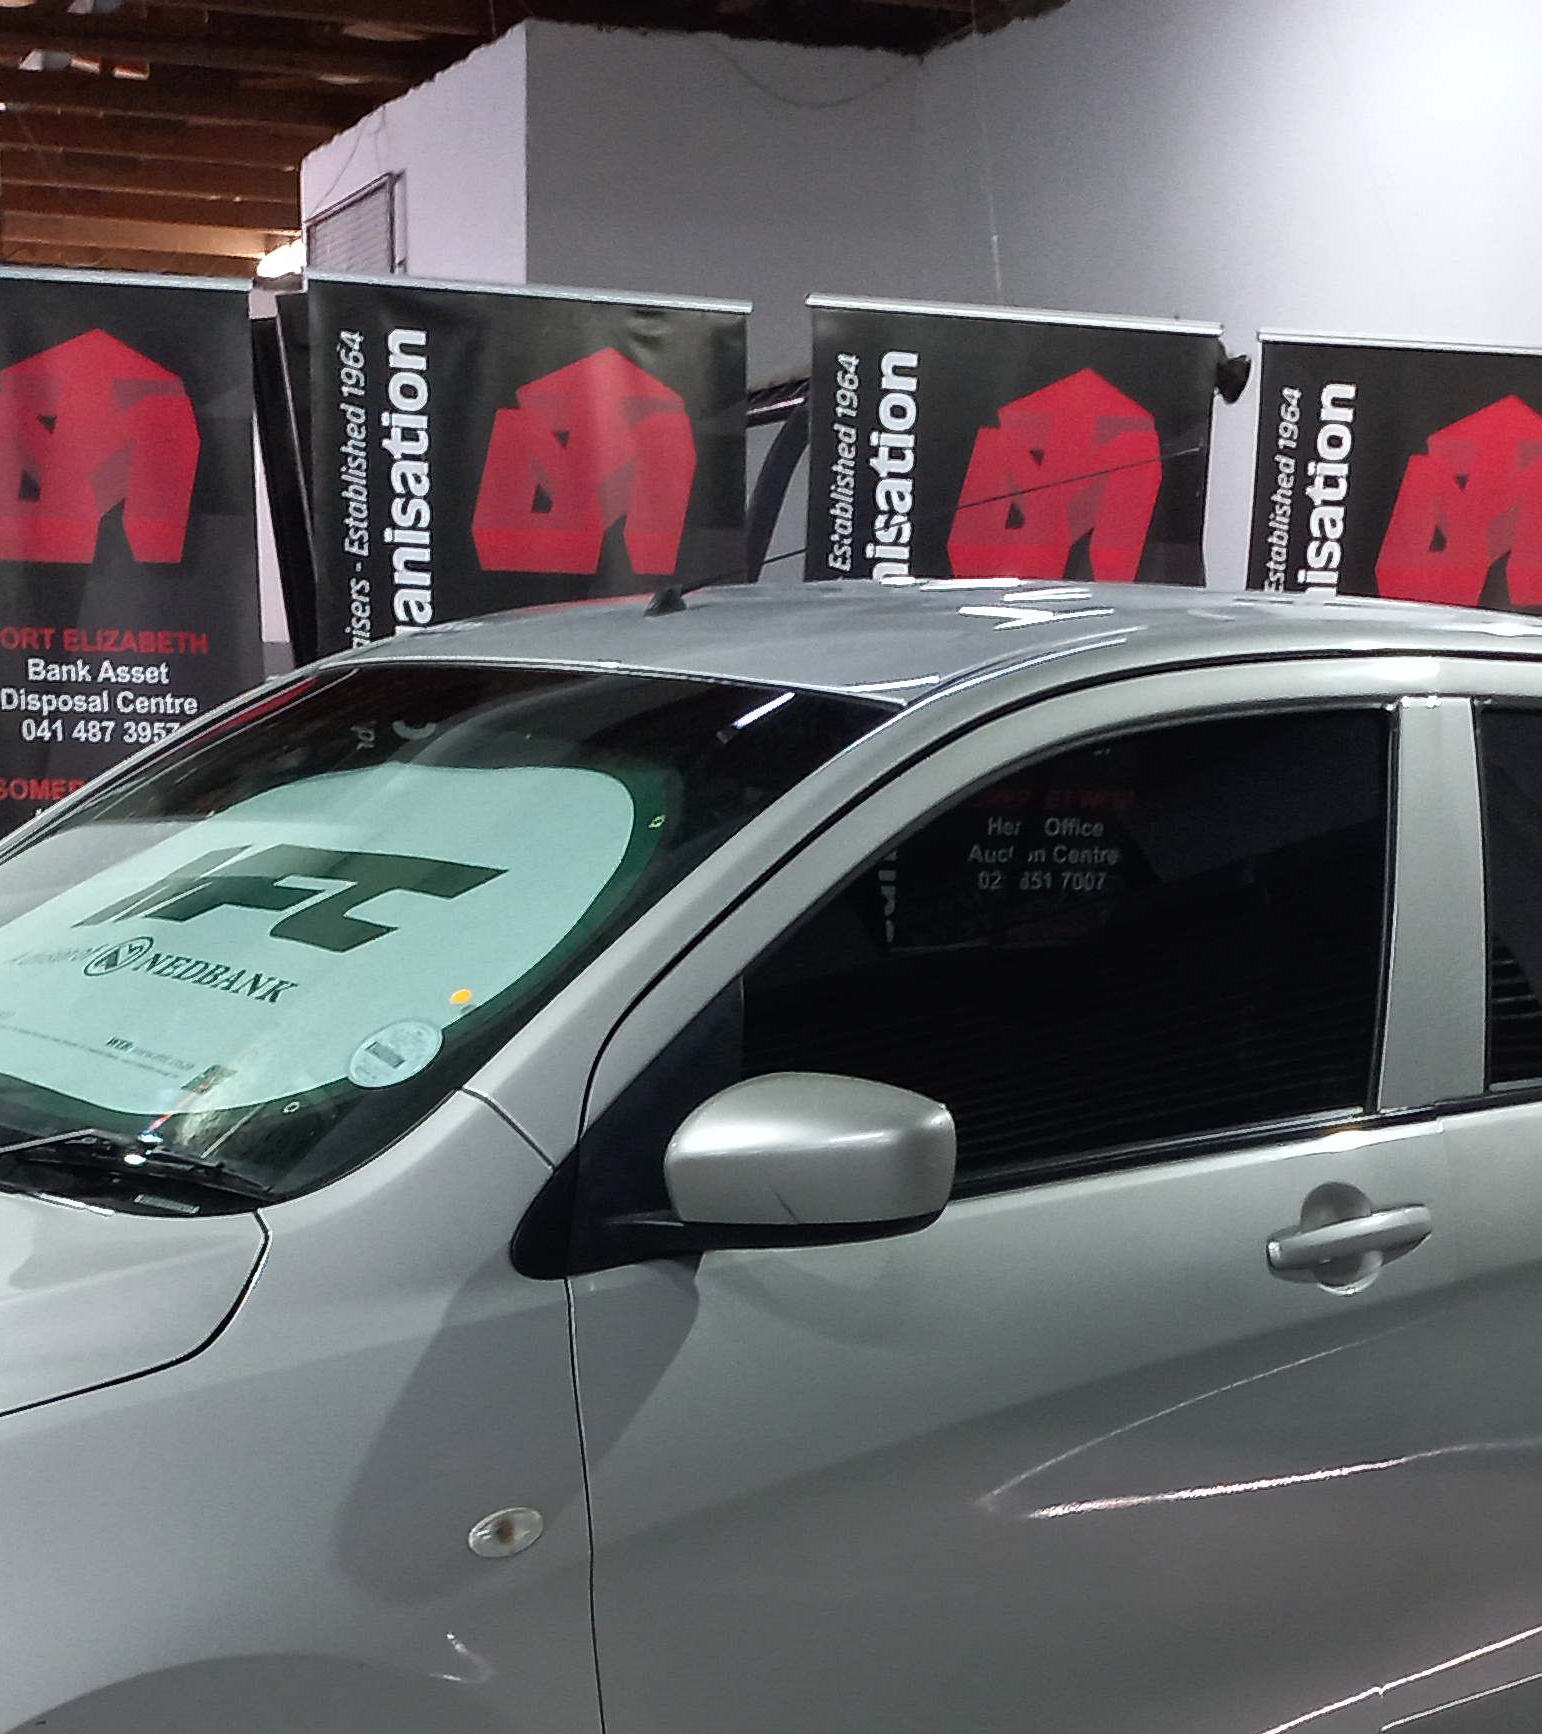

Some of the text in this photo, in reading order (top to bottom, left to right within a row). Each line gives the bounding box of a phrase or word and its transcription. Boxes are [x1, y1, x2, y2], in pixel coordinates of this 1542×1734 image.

[340, 330, 365, 397] 1964
[828, 353, 860, 572] Established 1964
[339, 402, 369, 557] Established
[1264, 387, 1302, 592] Established 1964
[62, 628, 209, 654] ELIZABETH
[26, 658, 171, 684] Bank Asset
[0, 687, 199, 715] Disposal Centre
[21, 718, 64, 742] 041
[71, 719, 116, 743] 487
[1043, 816, 1106, 838] Office
[1052, 843, 1121, 866] Centre
[1060, 871, 1108, 893] 7007
[132, 950, 300, 1004] NEDBANK
